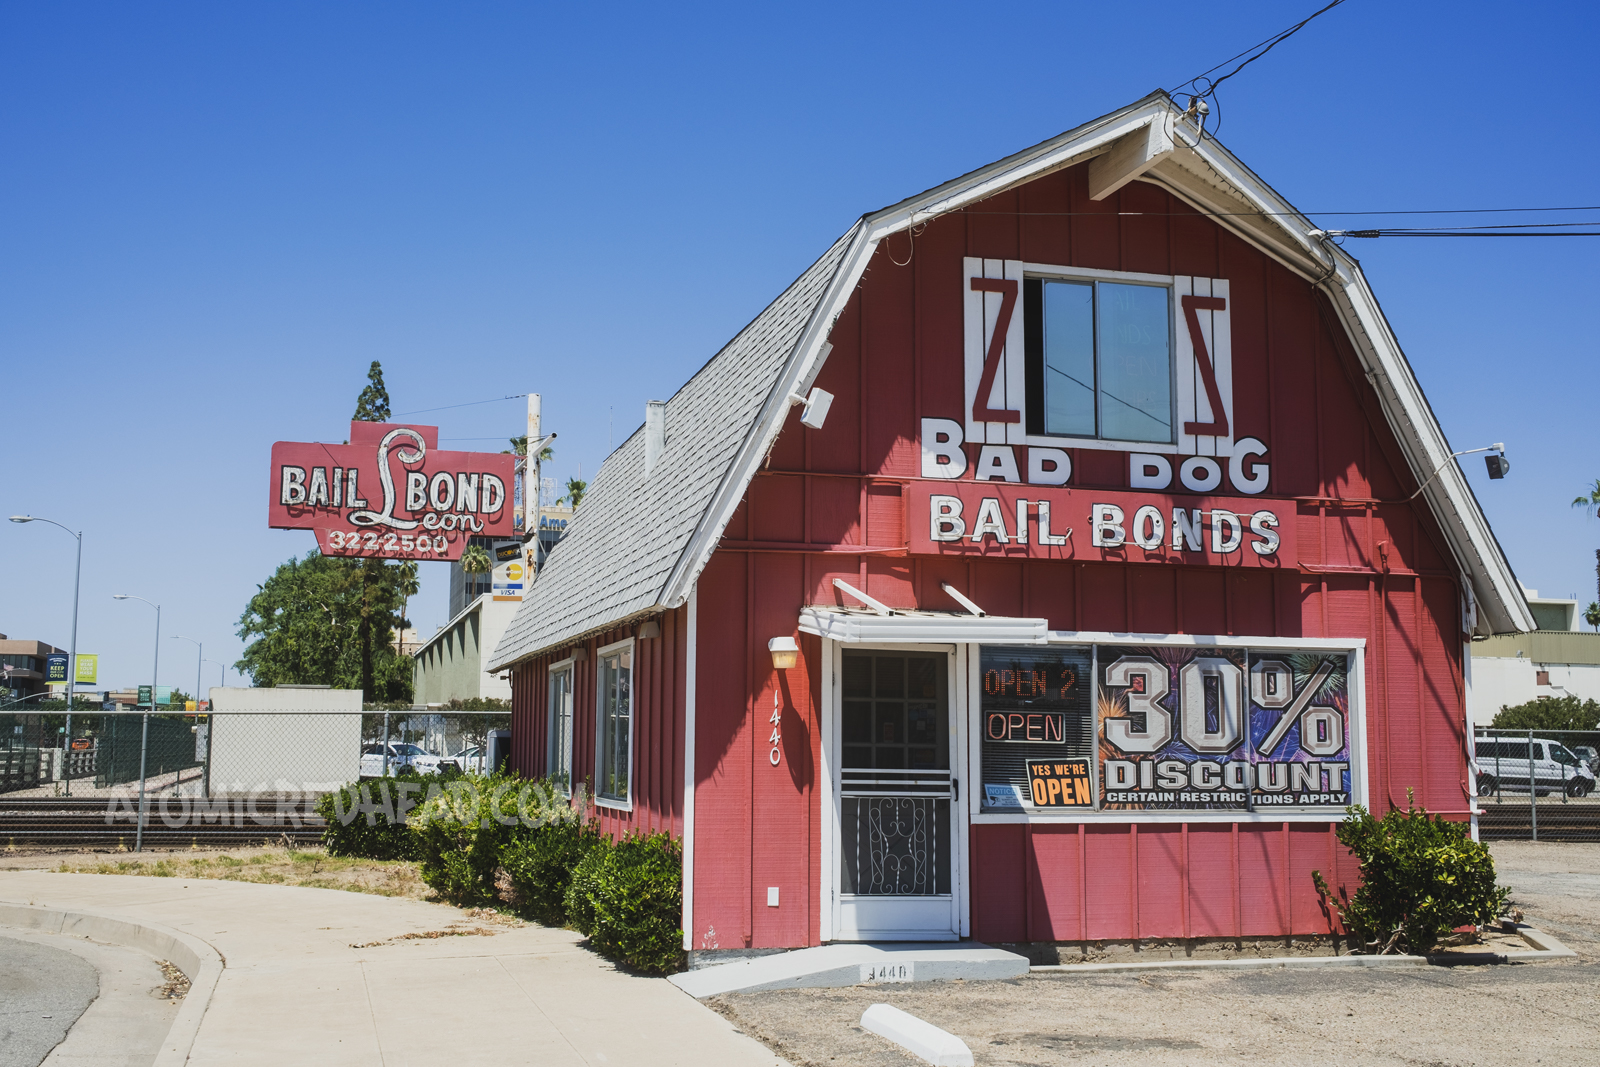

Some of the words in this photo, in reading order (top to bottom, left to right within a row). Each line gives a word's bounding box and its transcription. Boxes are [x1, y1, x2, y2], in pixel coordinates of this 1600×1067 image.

[920, 416, 1073, 486] BAD
[1129, 436, 1271, 495] DOG
[280, 464, 368, 509] BAIL
[405, 469, 506, 515] BOND
[346, 427, 485, 533] Leon
[929, 494, 1067, 546] BAIL
[1091, 502, 1281, 555] BONDS
[985, 668, 1047, 697] OPEN
[1060, 669, 1075, 700] 2
[1104, 655, 1345, 758] 30%
[769, 689, 781, 765] 1440
[988, 713, 1062, 742] OPEN
[1031, 764, 1051, 776] YES
[1053, 763, 1086, 776] WE'RE
[1104, 760, 1349, 792] DISCOUNT
[989, 787, 1017, 795] NOTICE
[1032, 777, 1091, 806] OPEN
[1106, 792, 1175, 803] CERTAIN
[1181, 792, 1294, 805] RESTRICTIONS
[1300, 793, 1347, 804] APPLY
